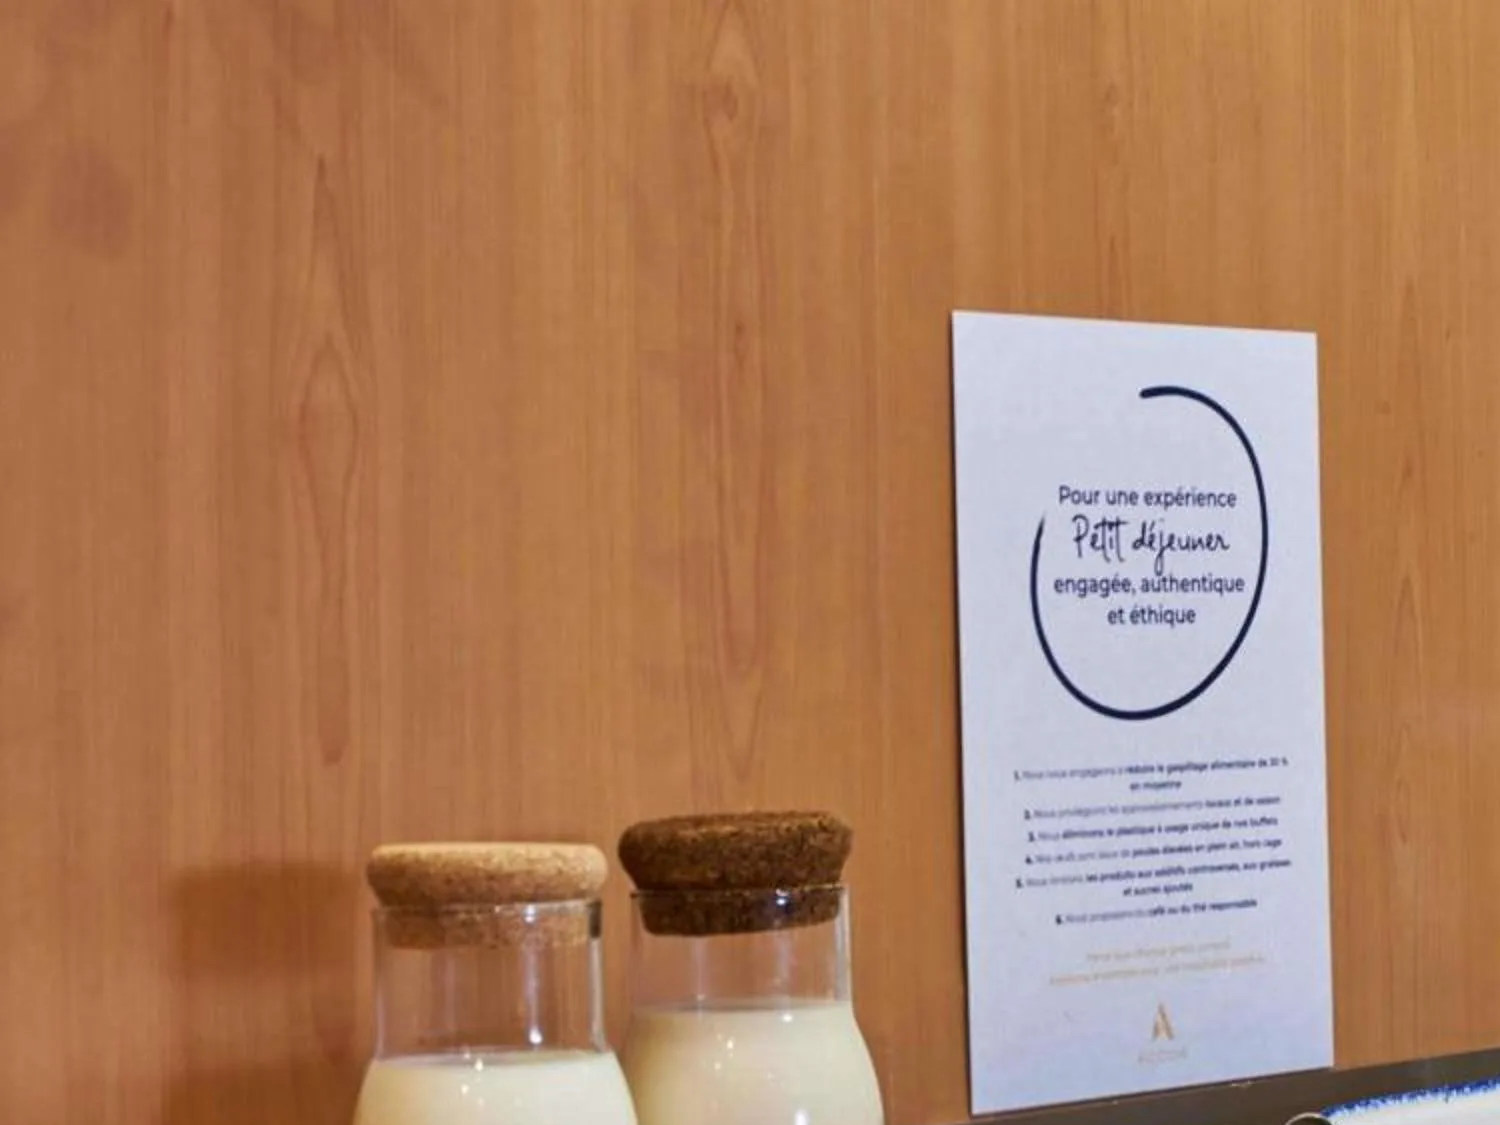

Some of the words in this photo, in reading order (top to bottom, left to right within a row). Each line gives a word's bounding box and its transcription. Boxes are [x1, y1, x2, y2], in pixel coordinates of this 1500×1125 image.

[1058, 485, 1100, 506] Pour
[1105, 489, 1139, 507] une
[1143, 486, 1237, 511] expérience
[1072, 514, 1129, 563] Petit
[1132, 518, 1230, 576] déjeuner
[1053, 575, 1137, 598] engagée,
[1141, 574, 1245, 598] authentique
[1107, 607, 1125, 624] et
[1130, 604, 1196, 628] éthique
